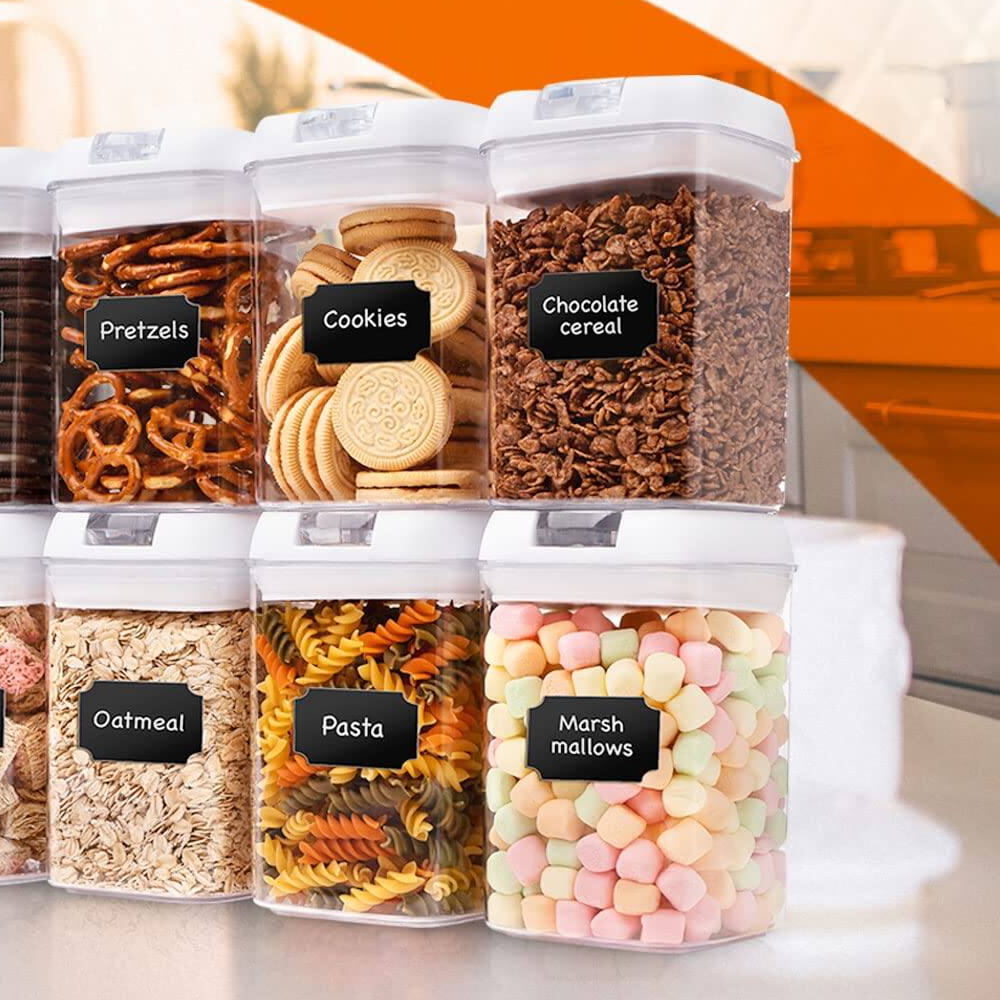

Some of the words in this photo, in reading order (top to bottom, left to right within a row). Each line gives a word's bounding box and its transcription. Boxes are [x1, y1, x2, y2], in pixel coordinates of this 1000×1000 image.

[543, 295, 638, 313] Chocolate
[324, 309, 407, 328] Cookies
[561, 317, 621, 335] cereal
[101, 320, 188, 340] Pretzels
[94, 711, 184, 731] Oatmeal
[322, 715, 383, 737] Pasta
[559, 715, 623, 732] Marsh
[552, 738, 633, 756] mallows
